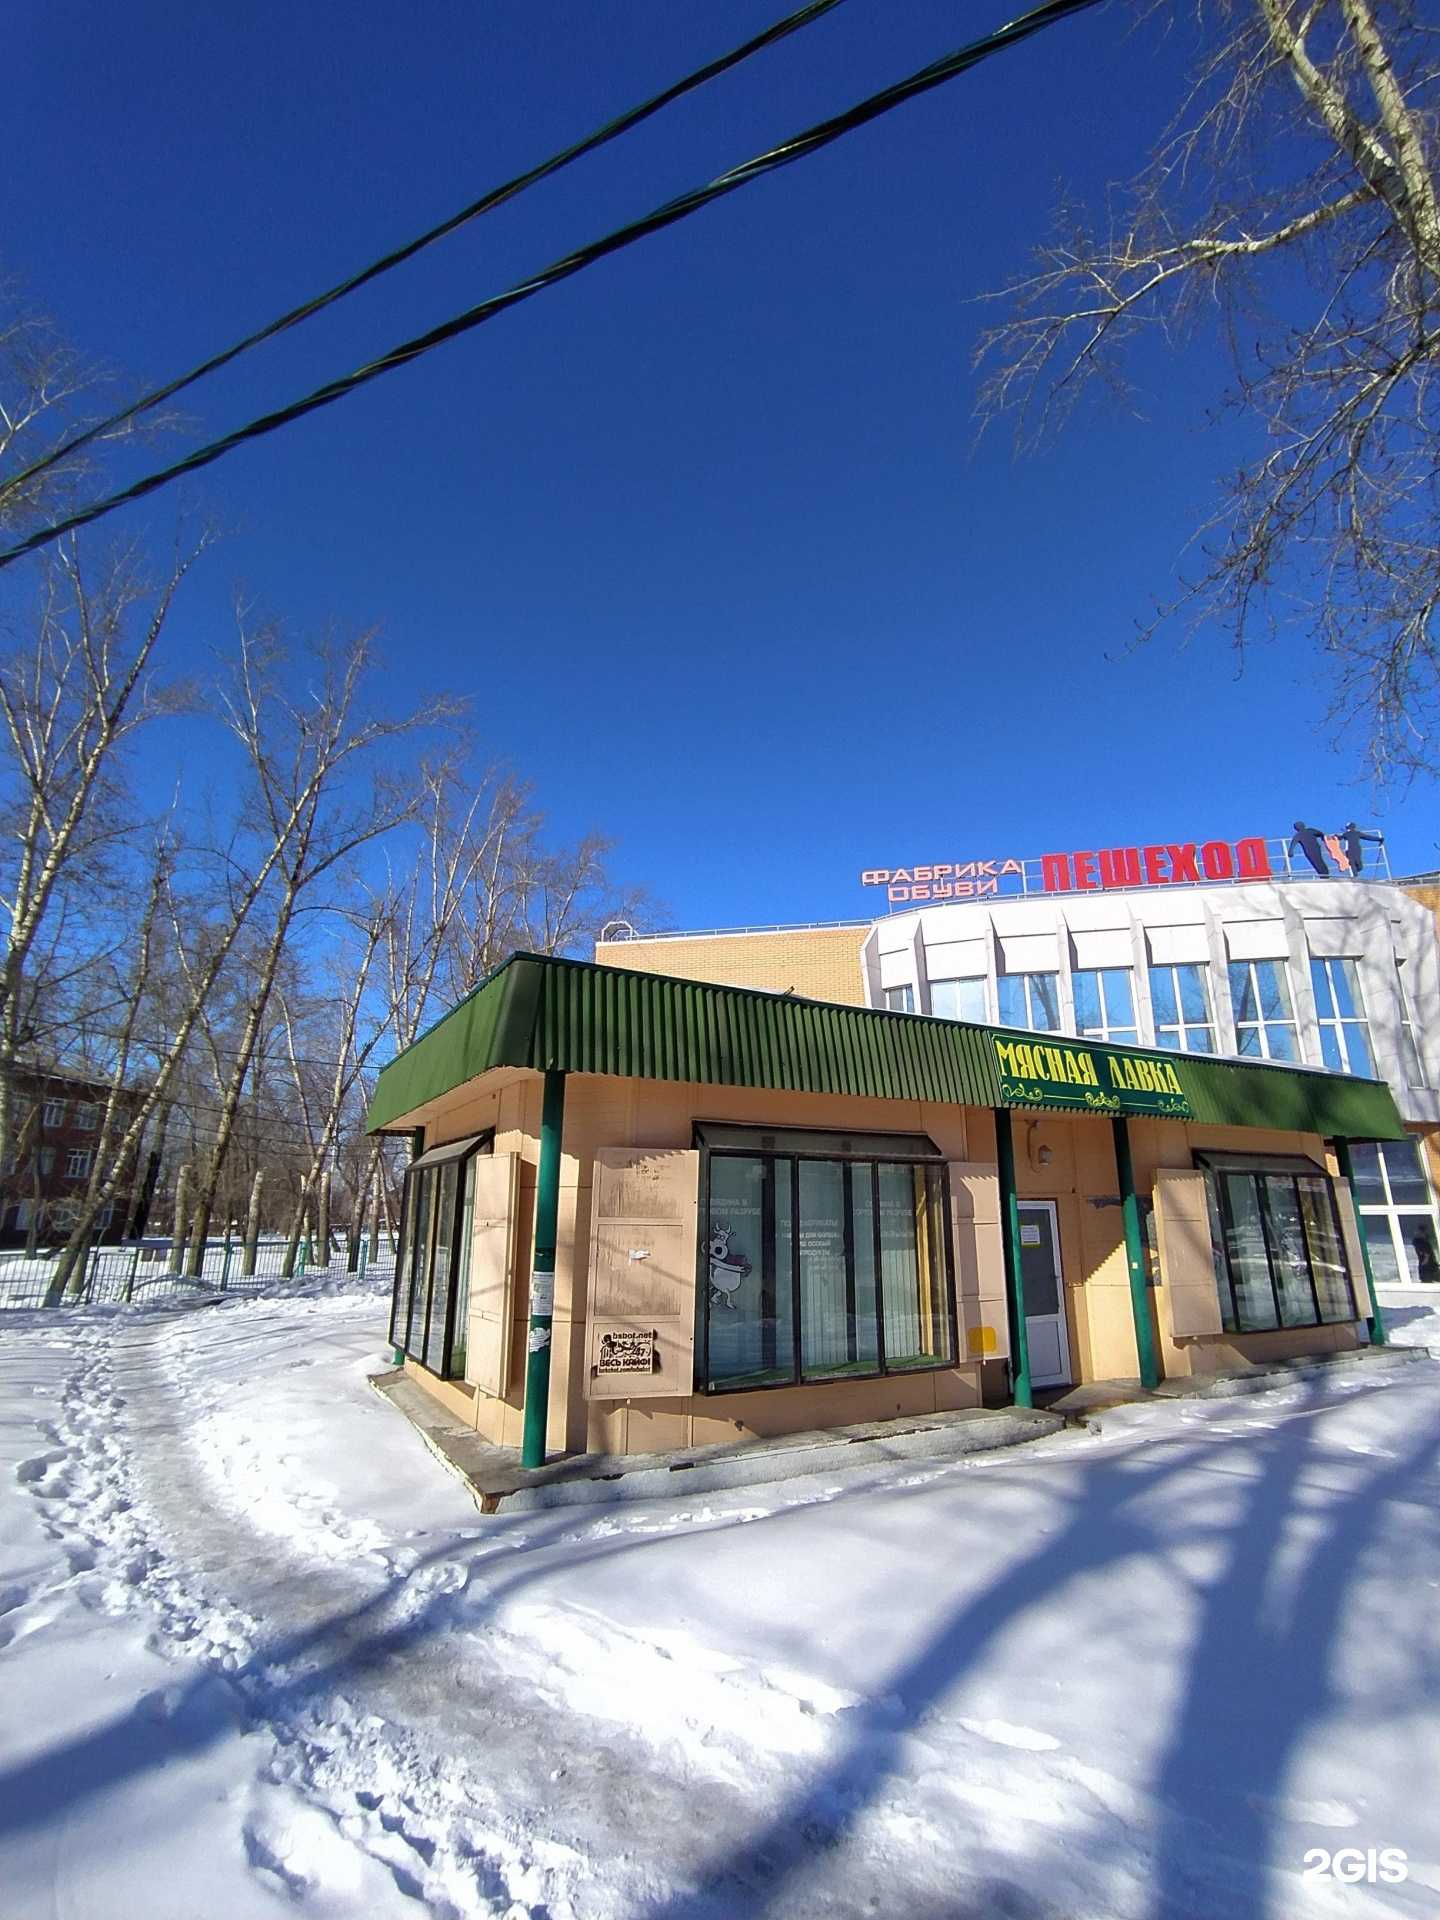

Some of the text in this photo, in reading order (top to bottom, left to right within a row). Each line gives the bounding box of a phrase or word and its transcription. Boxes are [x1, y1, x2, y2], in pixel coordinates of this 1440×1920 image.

[862, 859, 1022, 886] ФАБРИКА
[1041, 836, 1272, 893] ПЕШЕХОД
[888, 878, 998, 902] ОБУВИ
[995, 1040, 1184, 1095] МЯСНАЯ ЛАВКА
[599, 1359, 622, 1367] ВЕСЬ
